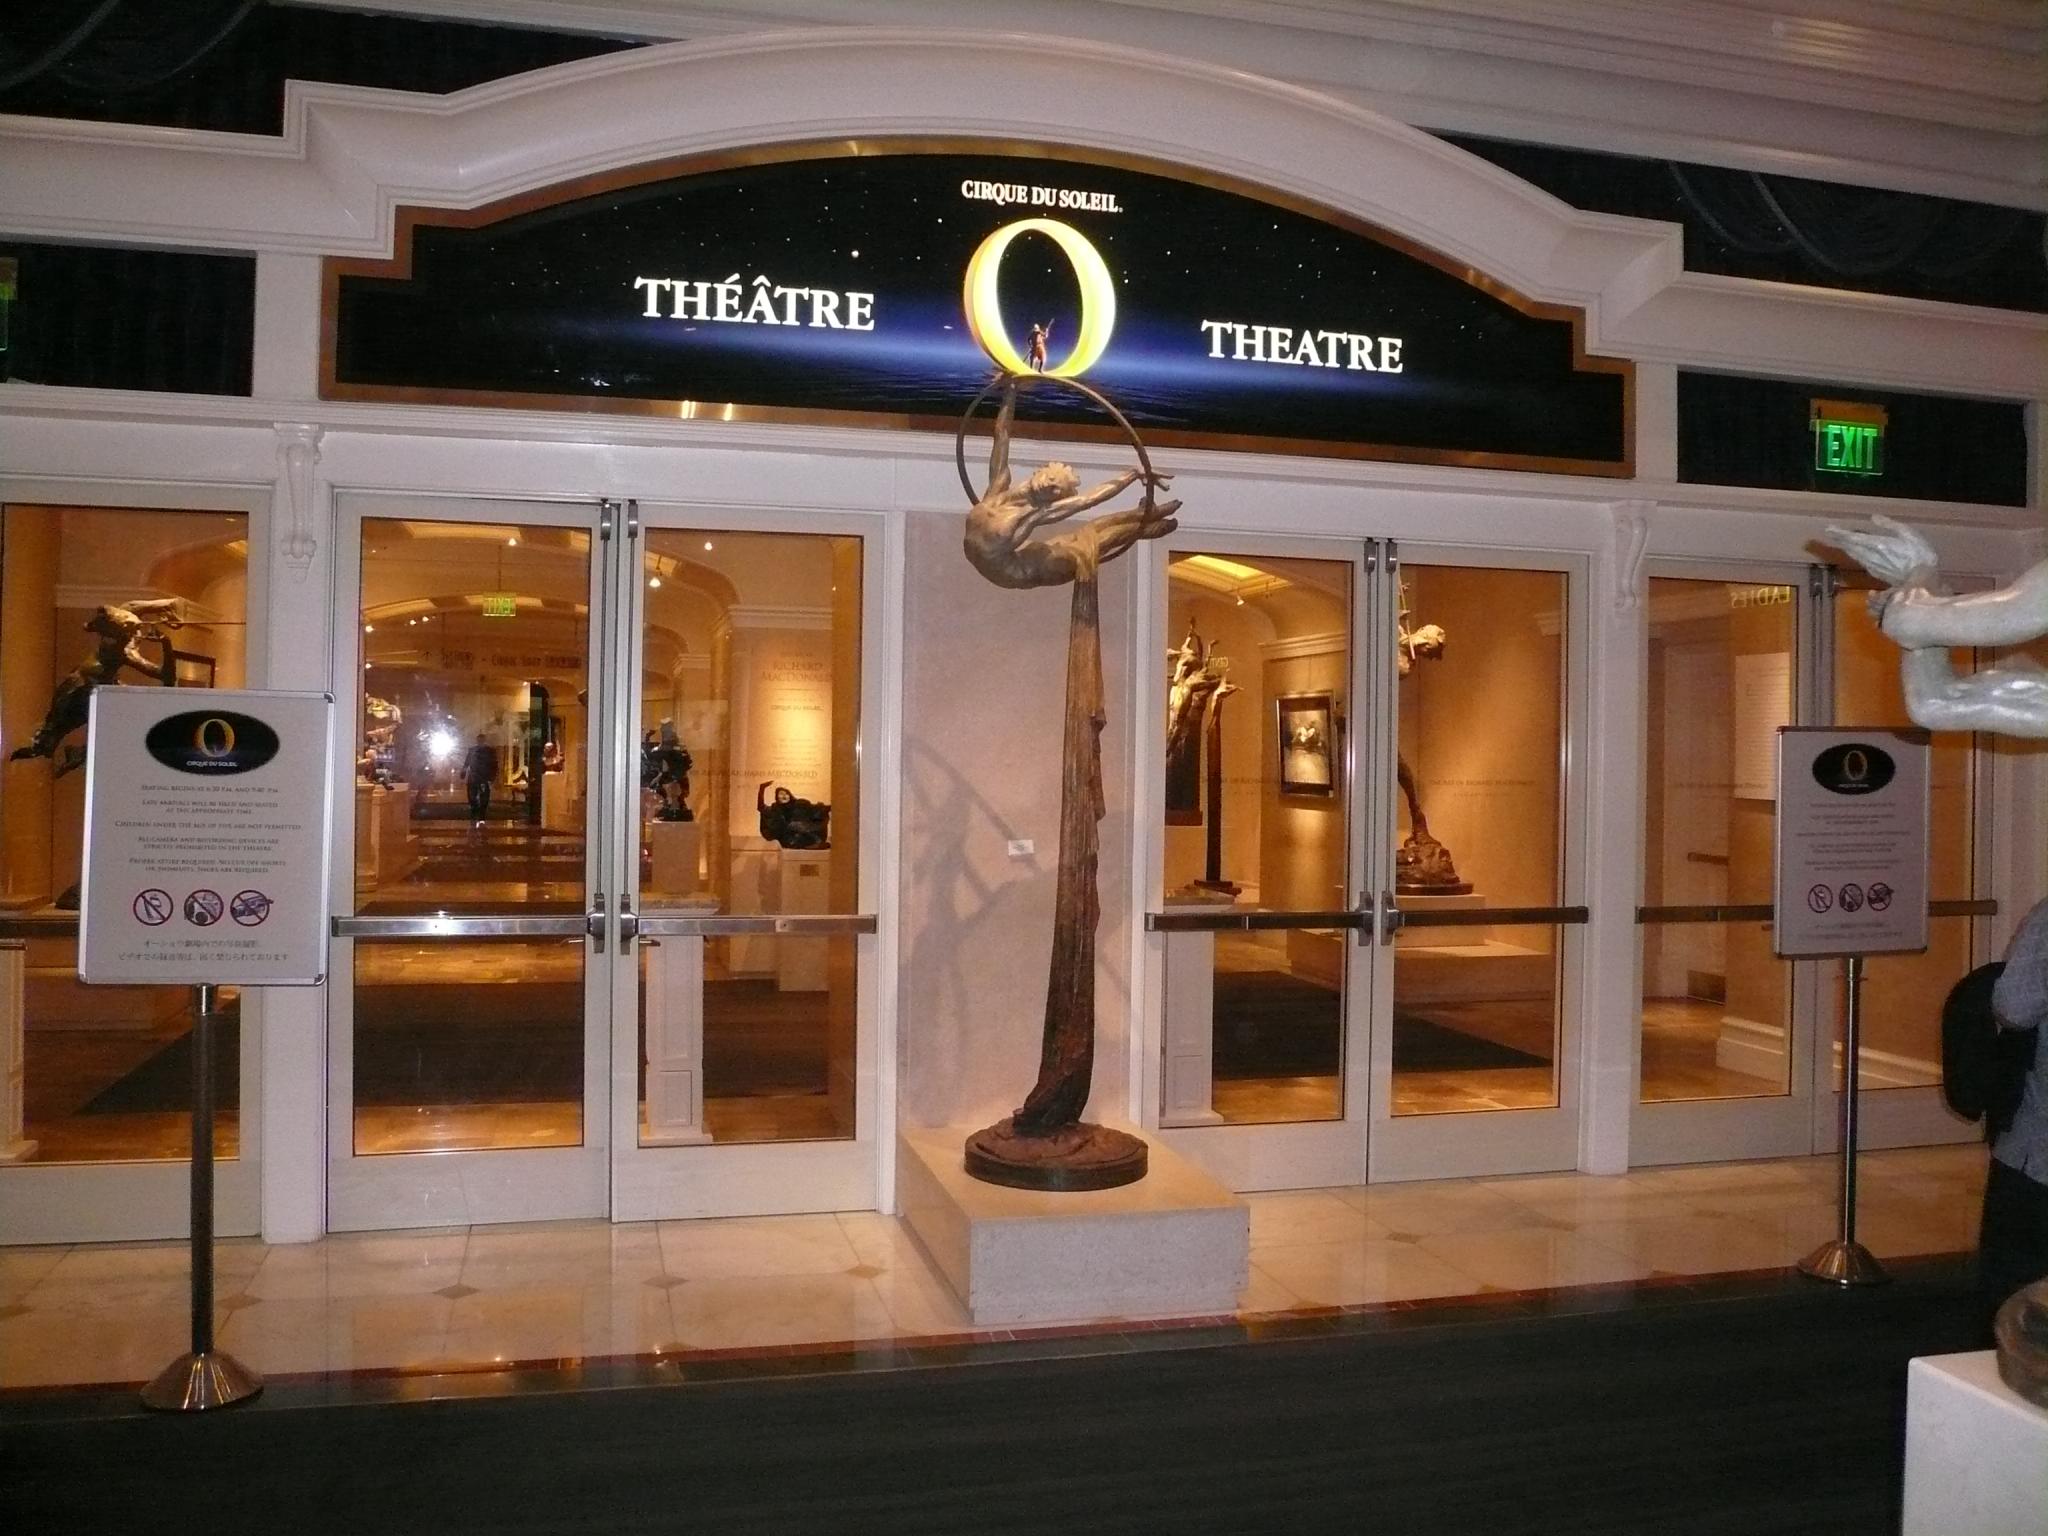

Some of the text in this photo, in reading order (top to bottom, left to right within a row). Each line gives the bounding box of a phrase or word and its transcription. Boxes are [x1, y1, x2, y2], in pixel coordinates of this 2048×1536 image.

[961, 180, 1119, 213] CIRQUE DU SOLEIL
[633, 272, 876, 331] THÉÂTRE
[963, 218, 1116, 377] O
[1200, 319, 1405, 374] THEATRE
[1827, 424, 1878, 469] EXIT
[193, 719, 235, 757] O
